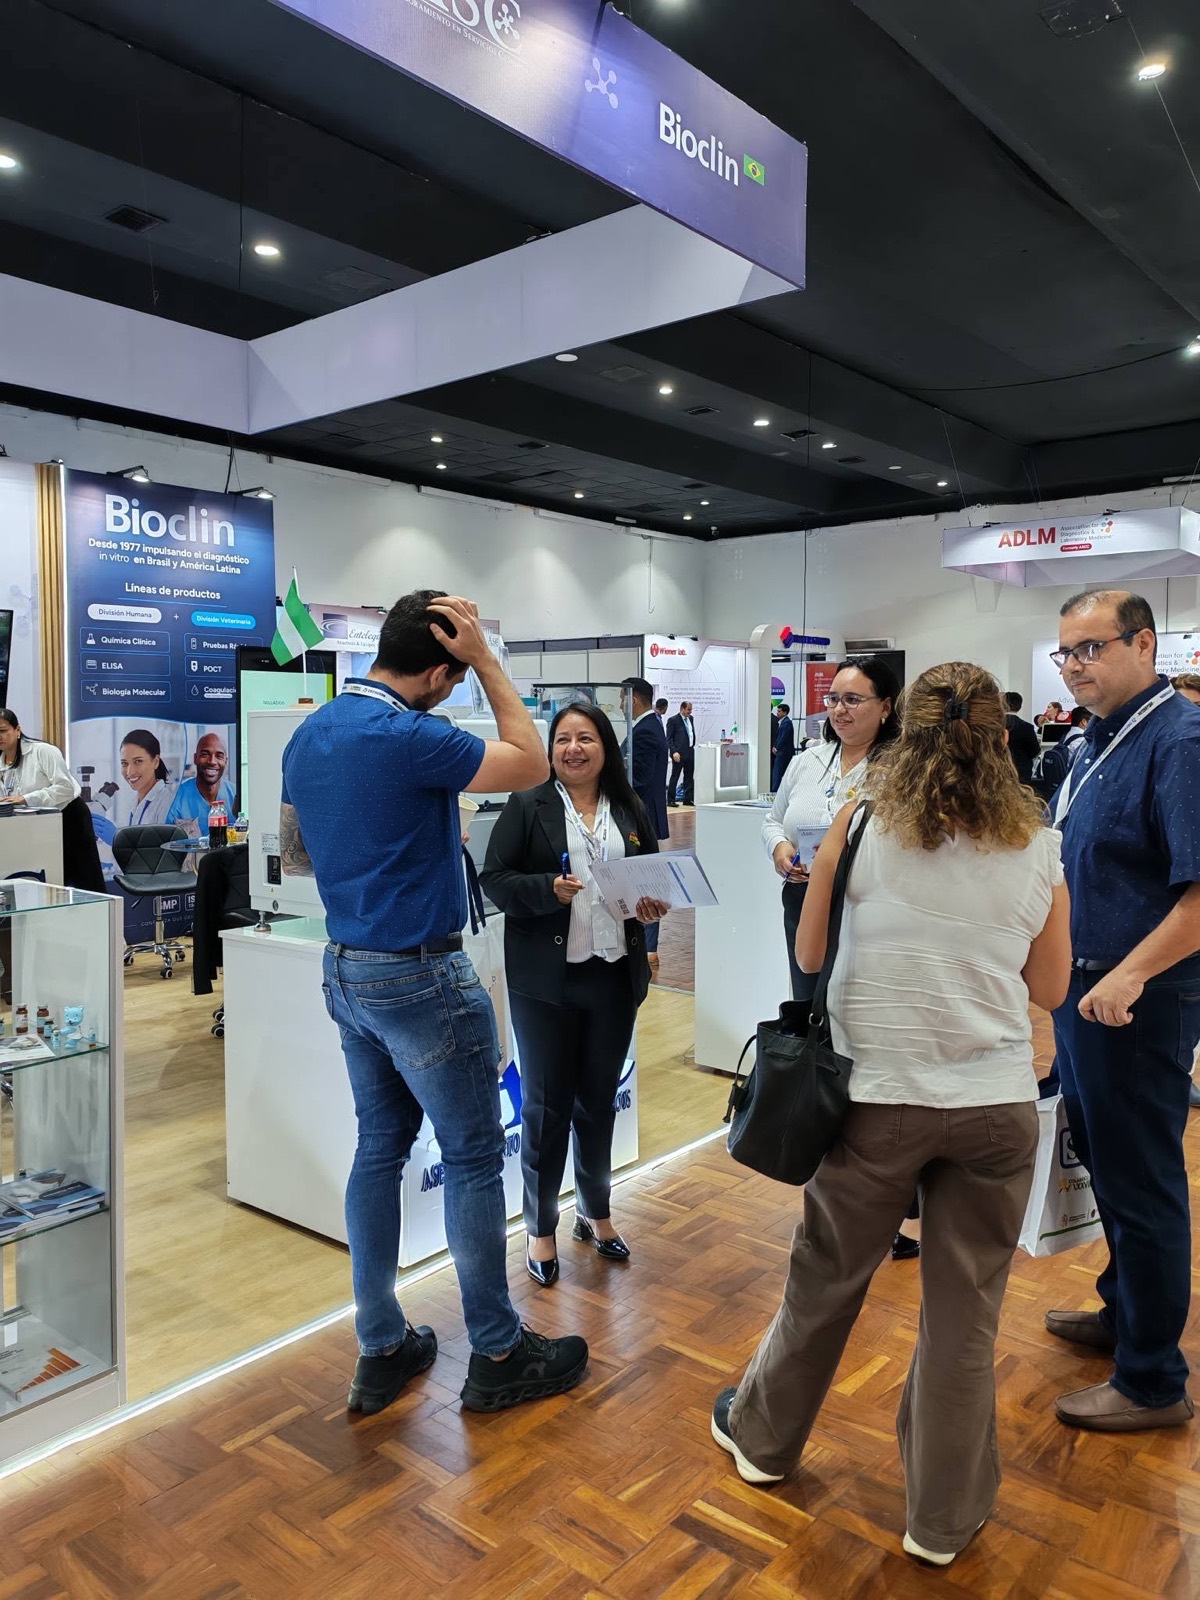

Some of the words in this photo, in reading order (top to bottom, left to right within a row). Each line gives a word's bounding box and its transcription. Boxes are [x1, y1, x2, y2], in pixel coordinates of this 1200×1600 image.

[659, 101, 739, 187] Bioclin
[105, 493, 235, 547] Bioclin
[998, 527, 1056, 548] ADLM
[88, 537, 118, 550] Desde
[119, 541, 140, 552] 1977
[142, 544, 192, 560] impulsando
[193, 549, 202, 559] el
[202, 551, 250, 566] diagnóstico
[99, 550, 108, 560] in
[109, 552, 130, 563] vitro
[133, 556, 146, 564] en
[147, 555, 171, 567] Brasil
[172, 560, 178, 569] y
[179, 559, 215, 572] América
[216, 564, 241, 574] Latina
[125, 582, 157, 595] Líneas
[158, 585, 171, 596] de
[173, 586, 221, 600] productos
[98, 608, 125, 618] División
[125, 611, 152, 619] Humana
[196, 615, 220, 623] División
[220, 617, 251, 626] Veterinaria
[101, 636, 131, 646] Química
[131, 637, 156, 646] Clínica
[202, 641, 229, 650] Pruebas
[101, 662, 124, 671] ELISA
[203, 665, 222, 673] POCT
[102, 687, 131, 698] Biología
[132, 688, 166, 697] Molecular
[161, 899, 178, 910] MP
